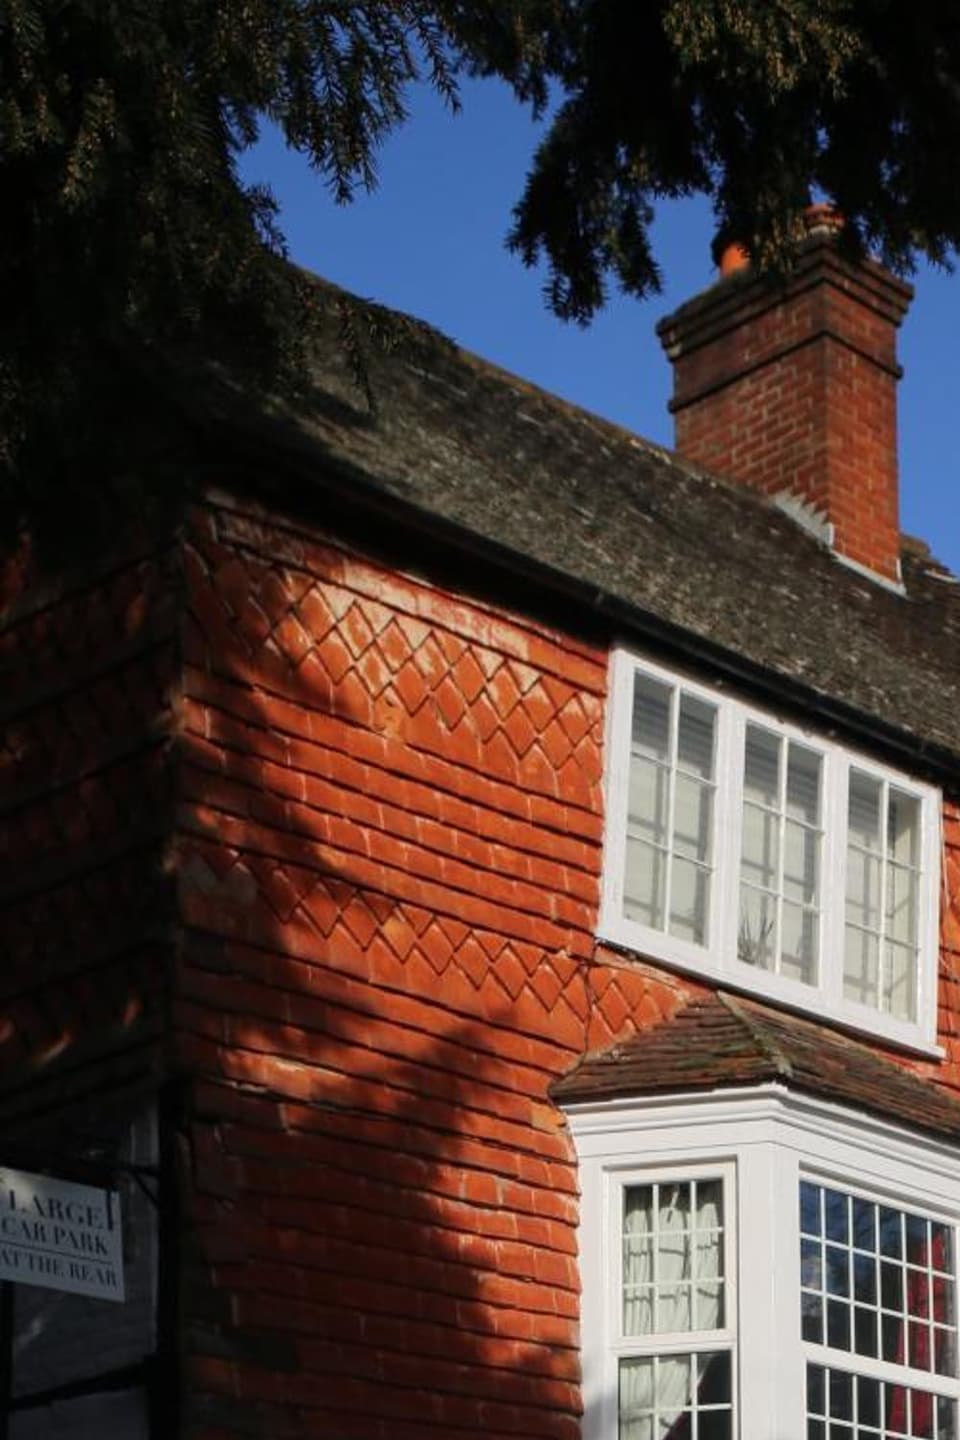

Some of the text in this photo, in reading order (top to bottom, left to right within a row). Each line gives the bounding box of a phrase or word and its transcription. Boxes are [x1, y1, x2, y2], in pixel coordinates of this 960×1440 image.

[9, 1188, 105, 1230] LARGE
[1, 1216, 108, 1256] CAR PARK
[25, 1252, 66, 1278] THE
[69, 1262, 118, 1290] REAR
